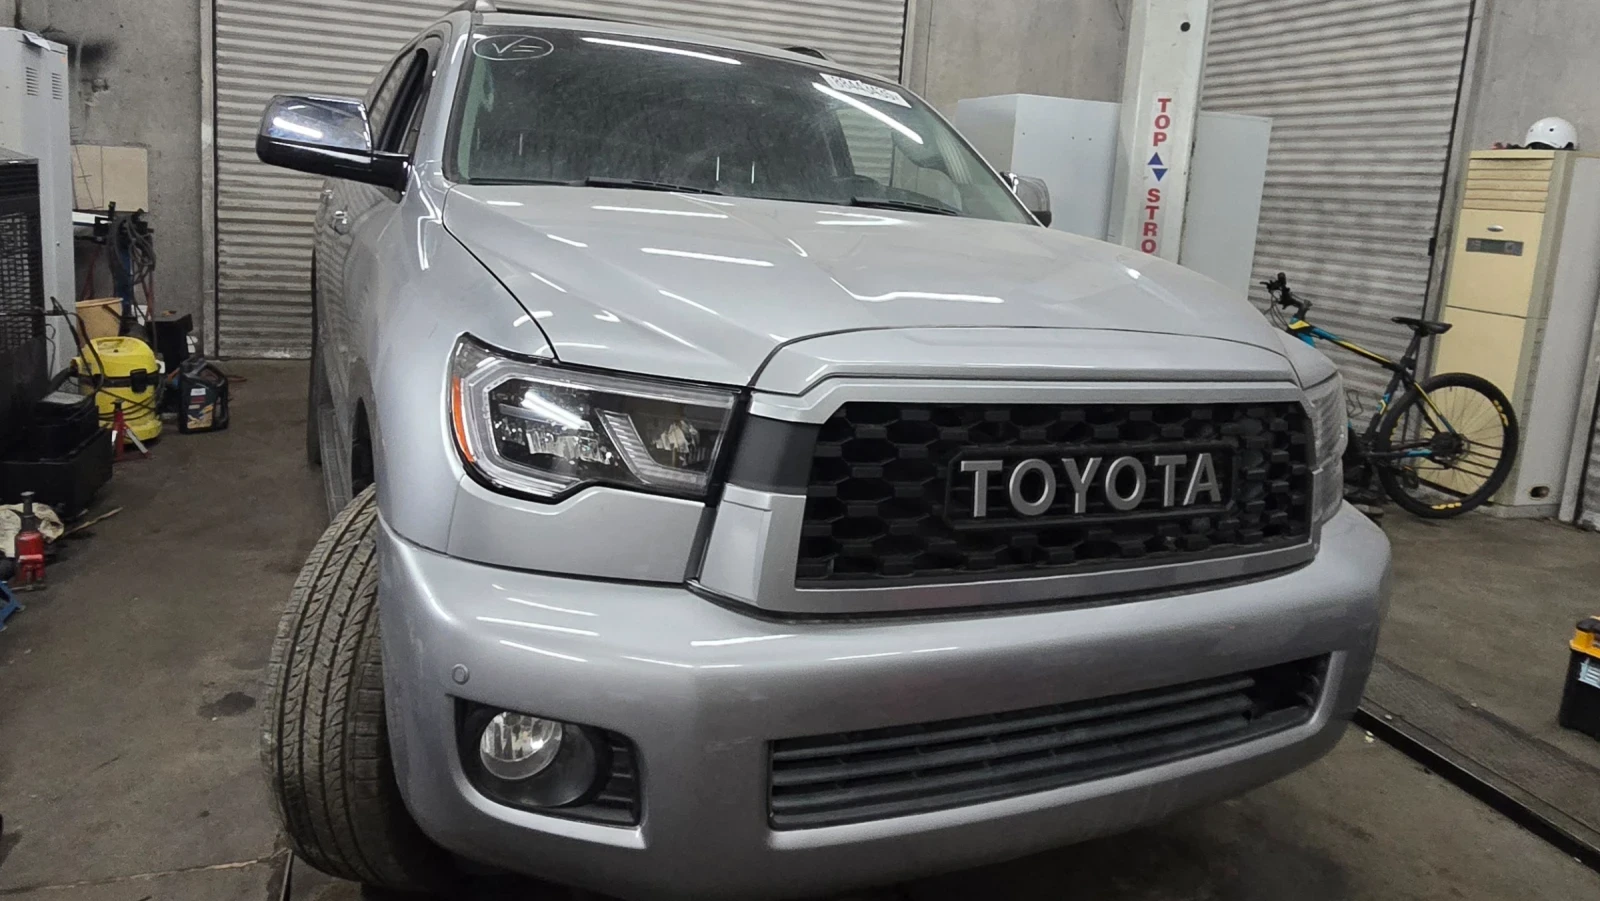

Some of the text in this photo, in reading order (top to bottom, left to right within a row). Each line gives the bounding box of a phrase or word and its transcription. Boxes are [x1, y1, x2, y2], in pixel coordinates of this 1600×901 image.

[1141, 98, 1172, 254] TOP STRO
[960, 453, 1222, 518] TOYOTA
